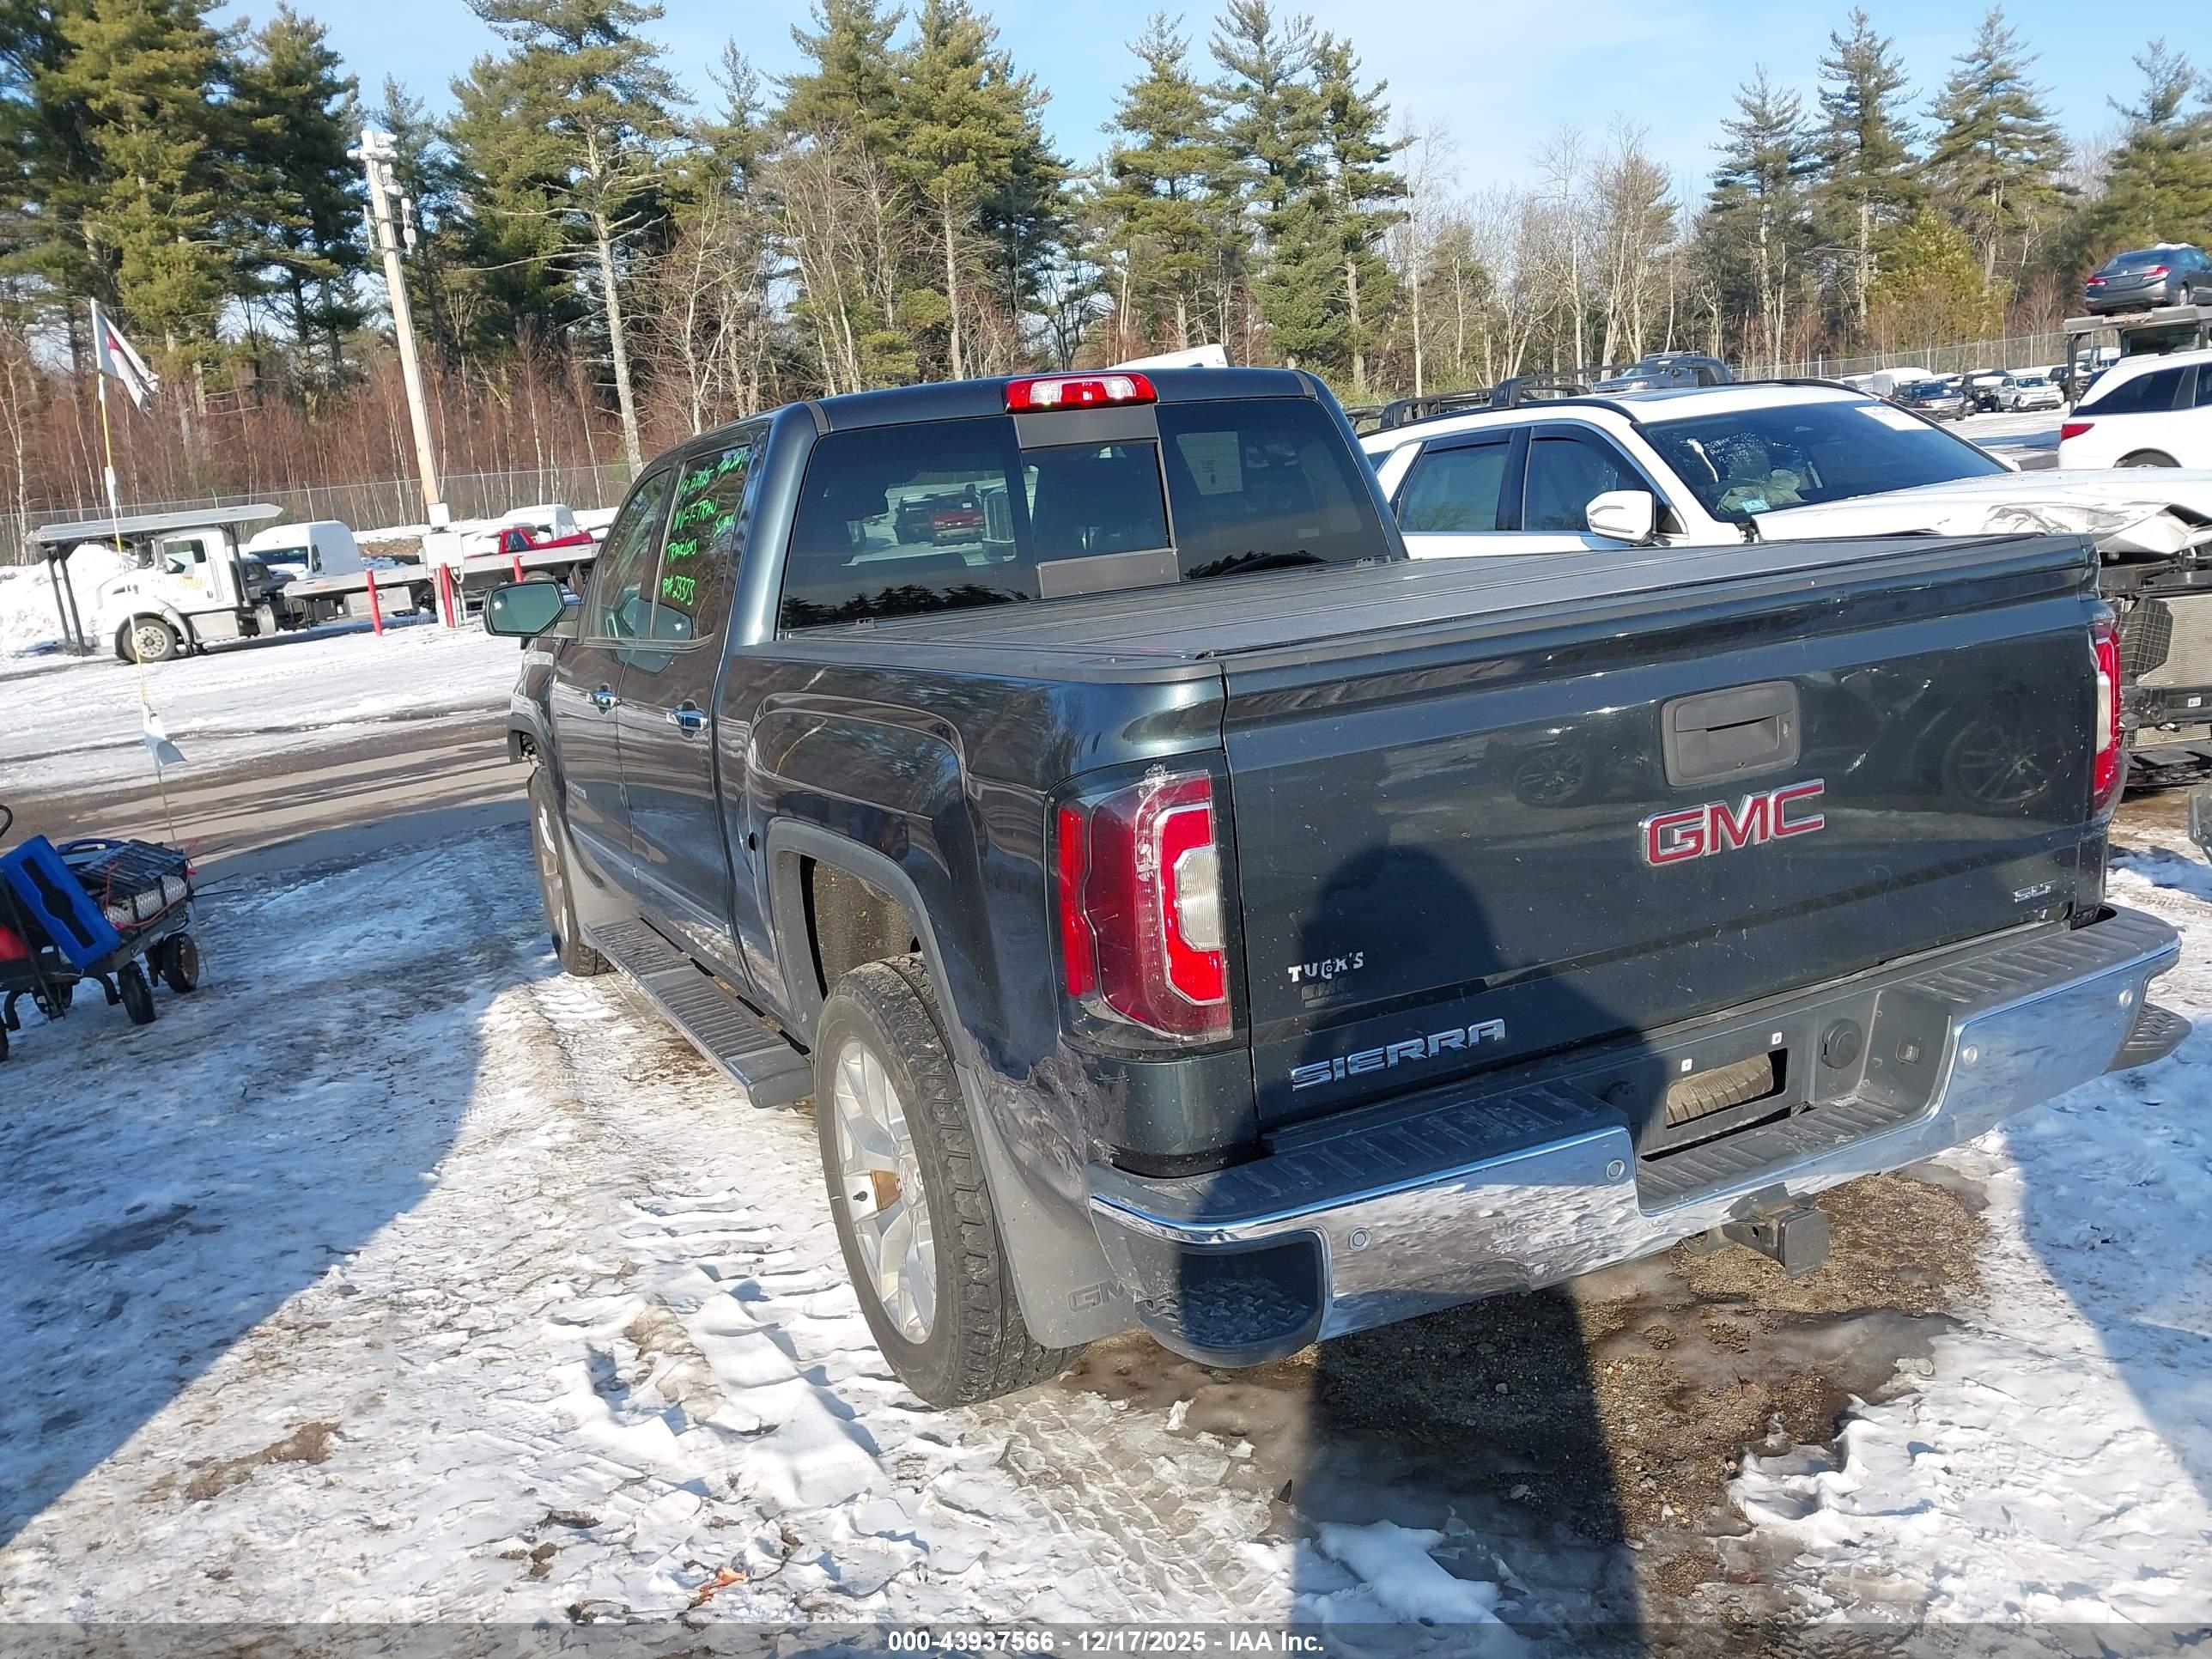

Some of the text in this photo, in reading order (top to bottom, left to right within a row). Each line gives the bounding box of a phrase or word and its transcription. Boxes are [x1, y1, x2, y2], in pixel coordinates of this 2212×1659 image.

[1638, 778, 1826, 866] GMC
[1288, 951, 1364, 983] TUCK'S
[1291, 1018, 1506, 1092] SIERRA
